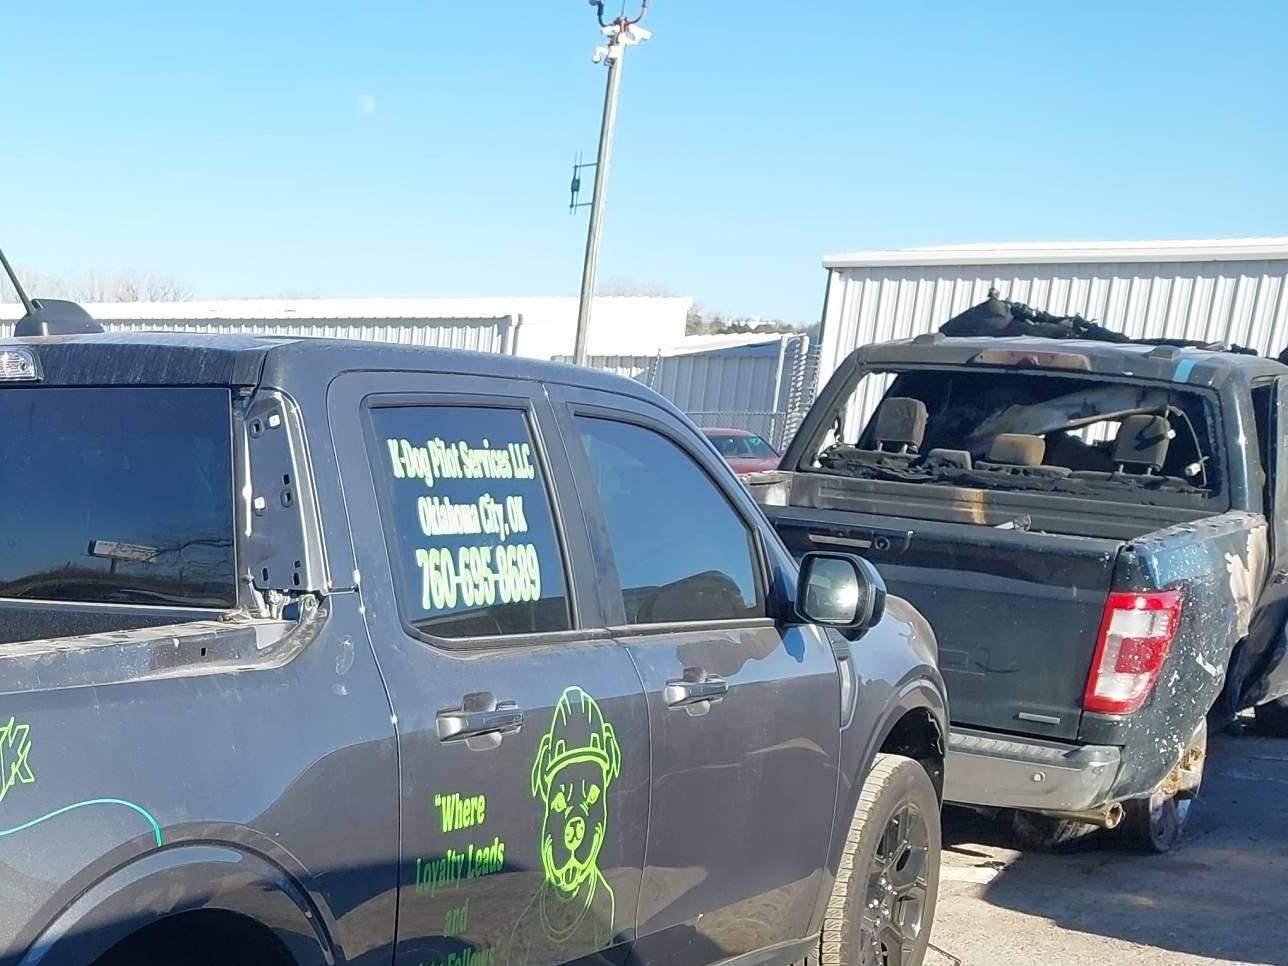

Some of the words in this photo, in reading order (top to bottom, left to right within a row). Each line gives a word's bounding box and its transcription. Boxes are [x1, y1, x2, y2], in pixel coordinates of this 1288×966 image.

[387, 438, 434, 487] K-Dog
[427, 437, 463, 478] Pilot
[459, 438, 513, 479] Services
[508, 443, 535, 480] LLC
[418, 496, 482, 536] Oklahoma
[479, 493, 510, 541] City,
[507, 495, 528, 533] OK
[415, 849, 465, 898] Loyalty
[466, 836, 505, 880] Leads
[443, 898, 469, 938] and
